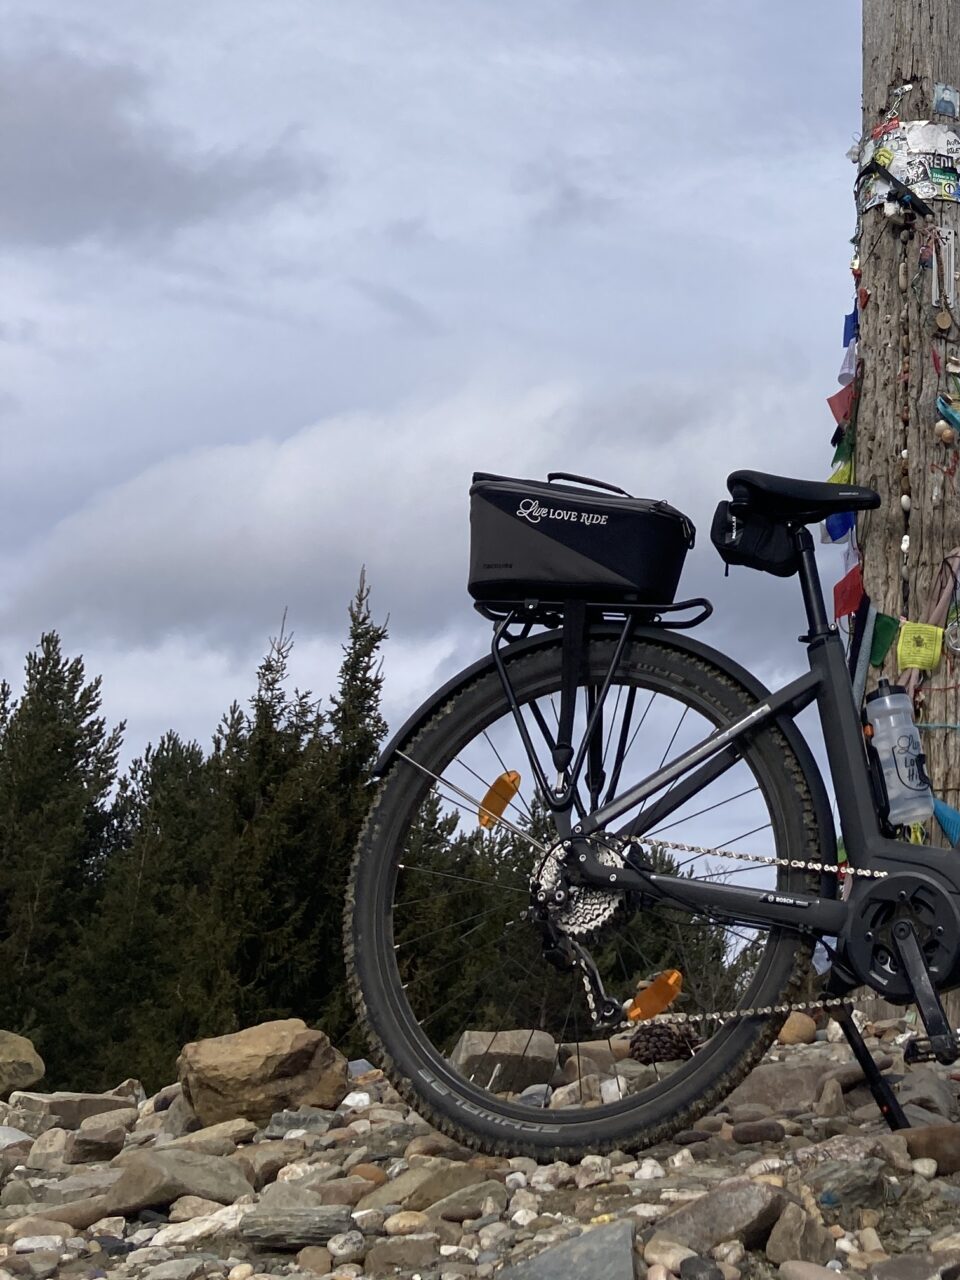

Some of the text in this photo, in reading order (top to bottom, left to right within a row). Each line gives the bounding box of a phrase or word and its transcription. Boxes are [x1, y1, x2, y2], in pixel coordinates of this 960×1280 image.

[516, 498, 608, 525] Live LOVE RIDE
[417, 1069, 562, 1133] SCHWALBE
